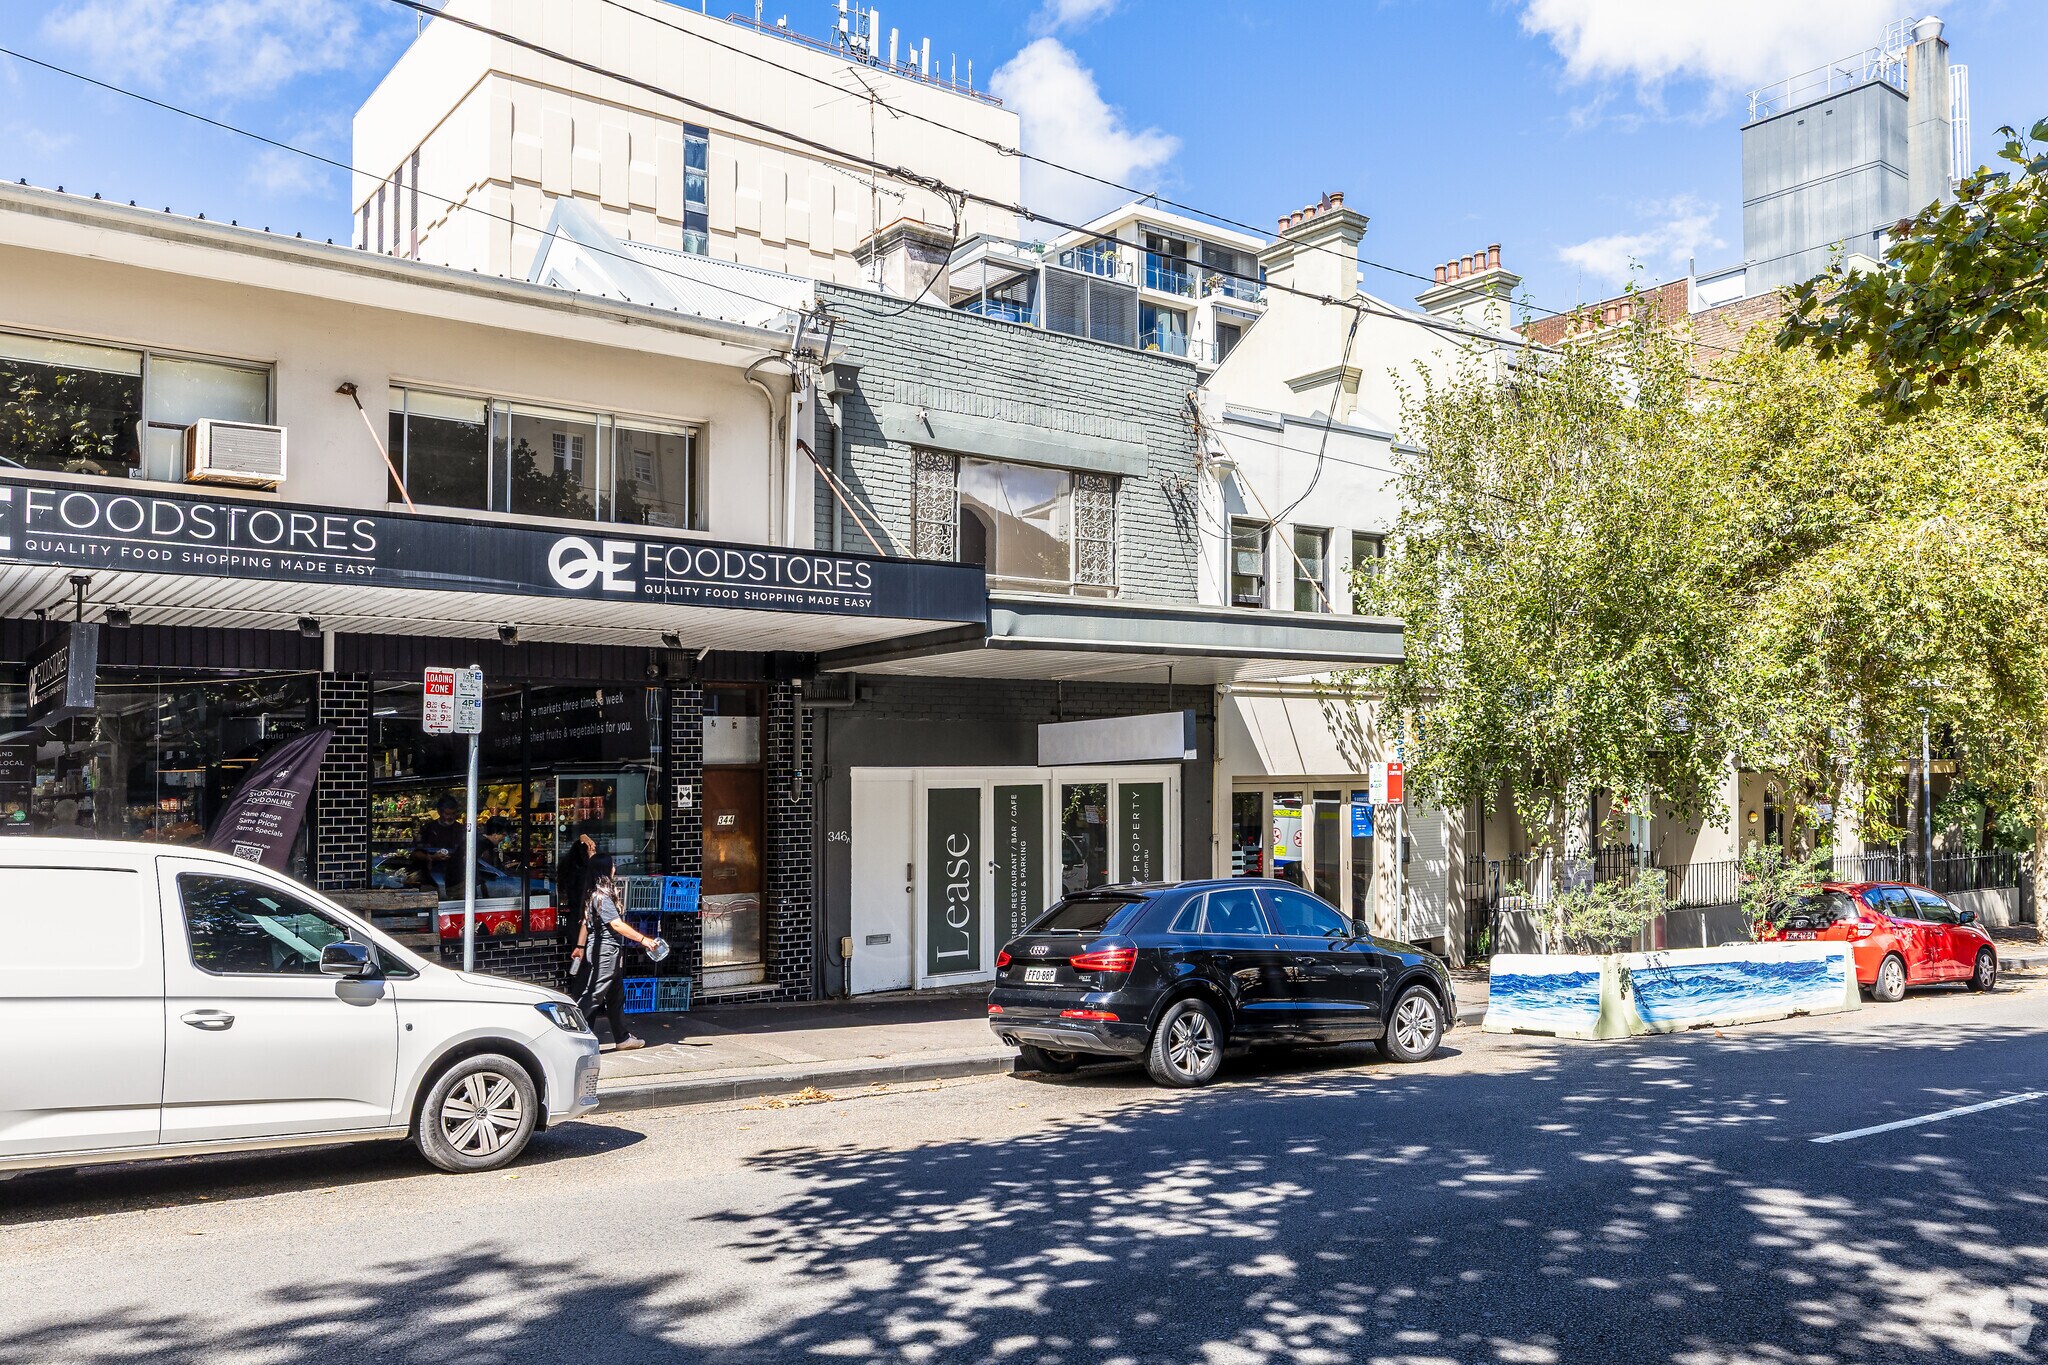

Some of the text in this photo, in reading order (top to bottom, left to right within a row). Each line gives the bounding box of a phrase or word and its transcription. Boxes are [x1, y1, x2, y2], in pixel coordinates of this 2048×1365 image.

[26, 488, 377, 552] FOODSTORES
[25, 540, 376, 576] QUALITY FOOD SHOPPING MADE EASY
[645, 543, 872, 589] FOODSTORES
[644, 585, 872, 608] QUALITY FOOD SHOPPING MADE EASY
[428, 674, 453, 684] LOADING
[430, 684, 450, 694] ZONE
[538, 702, 562, 716] markets
[562, 700, 579, 712] three
[580, 697, 598, 708] times
[606, 692, 624, 705] week
[546, 729, 562, 740] fruits
[563, 727, 568, 738] &
[568, 723, 604, 738] vegetables
[606, 722, 616, 733] for
[617, 721, 632, 734] you.
[265, 798, 293, 808] ONLINE
[257, 819, 278, 828] Prices
[260, 812, 282, 821] Range
[718, 816, 734, 825] 344
[254, 826, 284, 838] Specials
[936, 833, 971, 963] Lease
